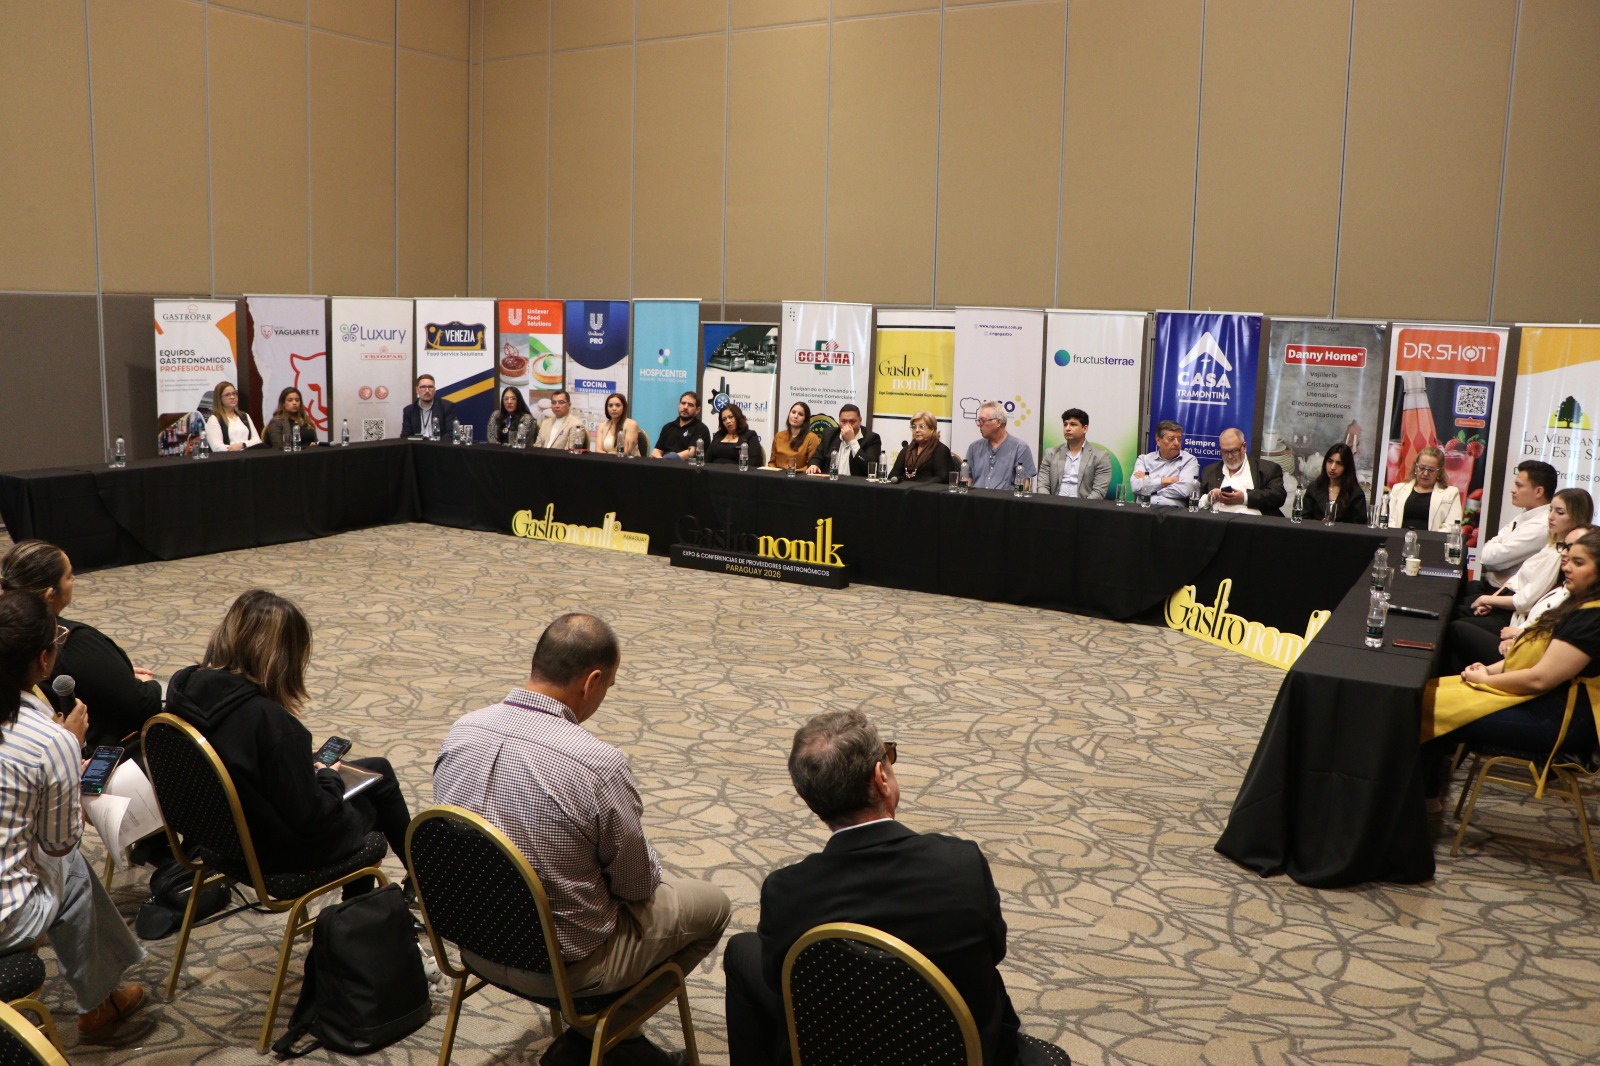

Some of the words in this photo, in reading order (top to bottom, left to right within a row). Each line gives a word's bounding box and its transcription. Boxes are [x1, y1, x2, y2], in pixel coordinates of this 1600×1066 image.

[163, 313, 211, 321] GASTROPAR
[360, 326, 407, 344] Luxury
[445, 329, 476, 343] VENEZIA
[1288, 349, 1324, 362] Danny
[1403, 342, 1489, 363] DR.SHOT
[159, 356, 232, 364] GASTRONÓMICOS
[798, 351, 851, 365] COEXMA
[1073, 353, 1135, 366] fructusterrae
[878, 354, 921, 377] Gastro
[640, 368, 688, 378] HOSPICENTER
[1310, 371, 1337, 379] Vajillería
[582, 381, 607, 389] COCINA
[1177, 371, 1231, 389] CASA
[1306, 381, 1339, 389] Cristalería
[1177, 389, 1231, 400] TRAMONTINA
[1306, 391, 1338, 399] Utensilios
[1291, 400, 1351, 410] Electrodomésticos
[1296, 410, 1344, 419] Organizadores
[1184, 438, 1216, 447] Siempre
[1203, 448, 1221, 456] cocin
[1585, 448, 1600, 461] S.
[623, 534, 648, 542] PARAGUAY
[682, 549, 696, 557] EXPO
[701, 552, 738, 563] CONFERENCIAS
[746, 560, 782, 570] PROVEEDORES
[782, 564, 830, 577] GASTRONÓMICOS
[725, 563, 763, 575] PARAGUAY
[764, 569, 781, 578] 2026
